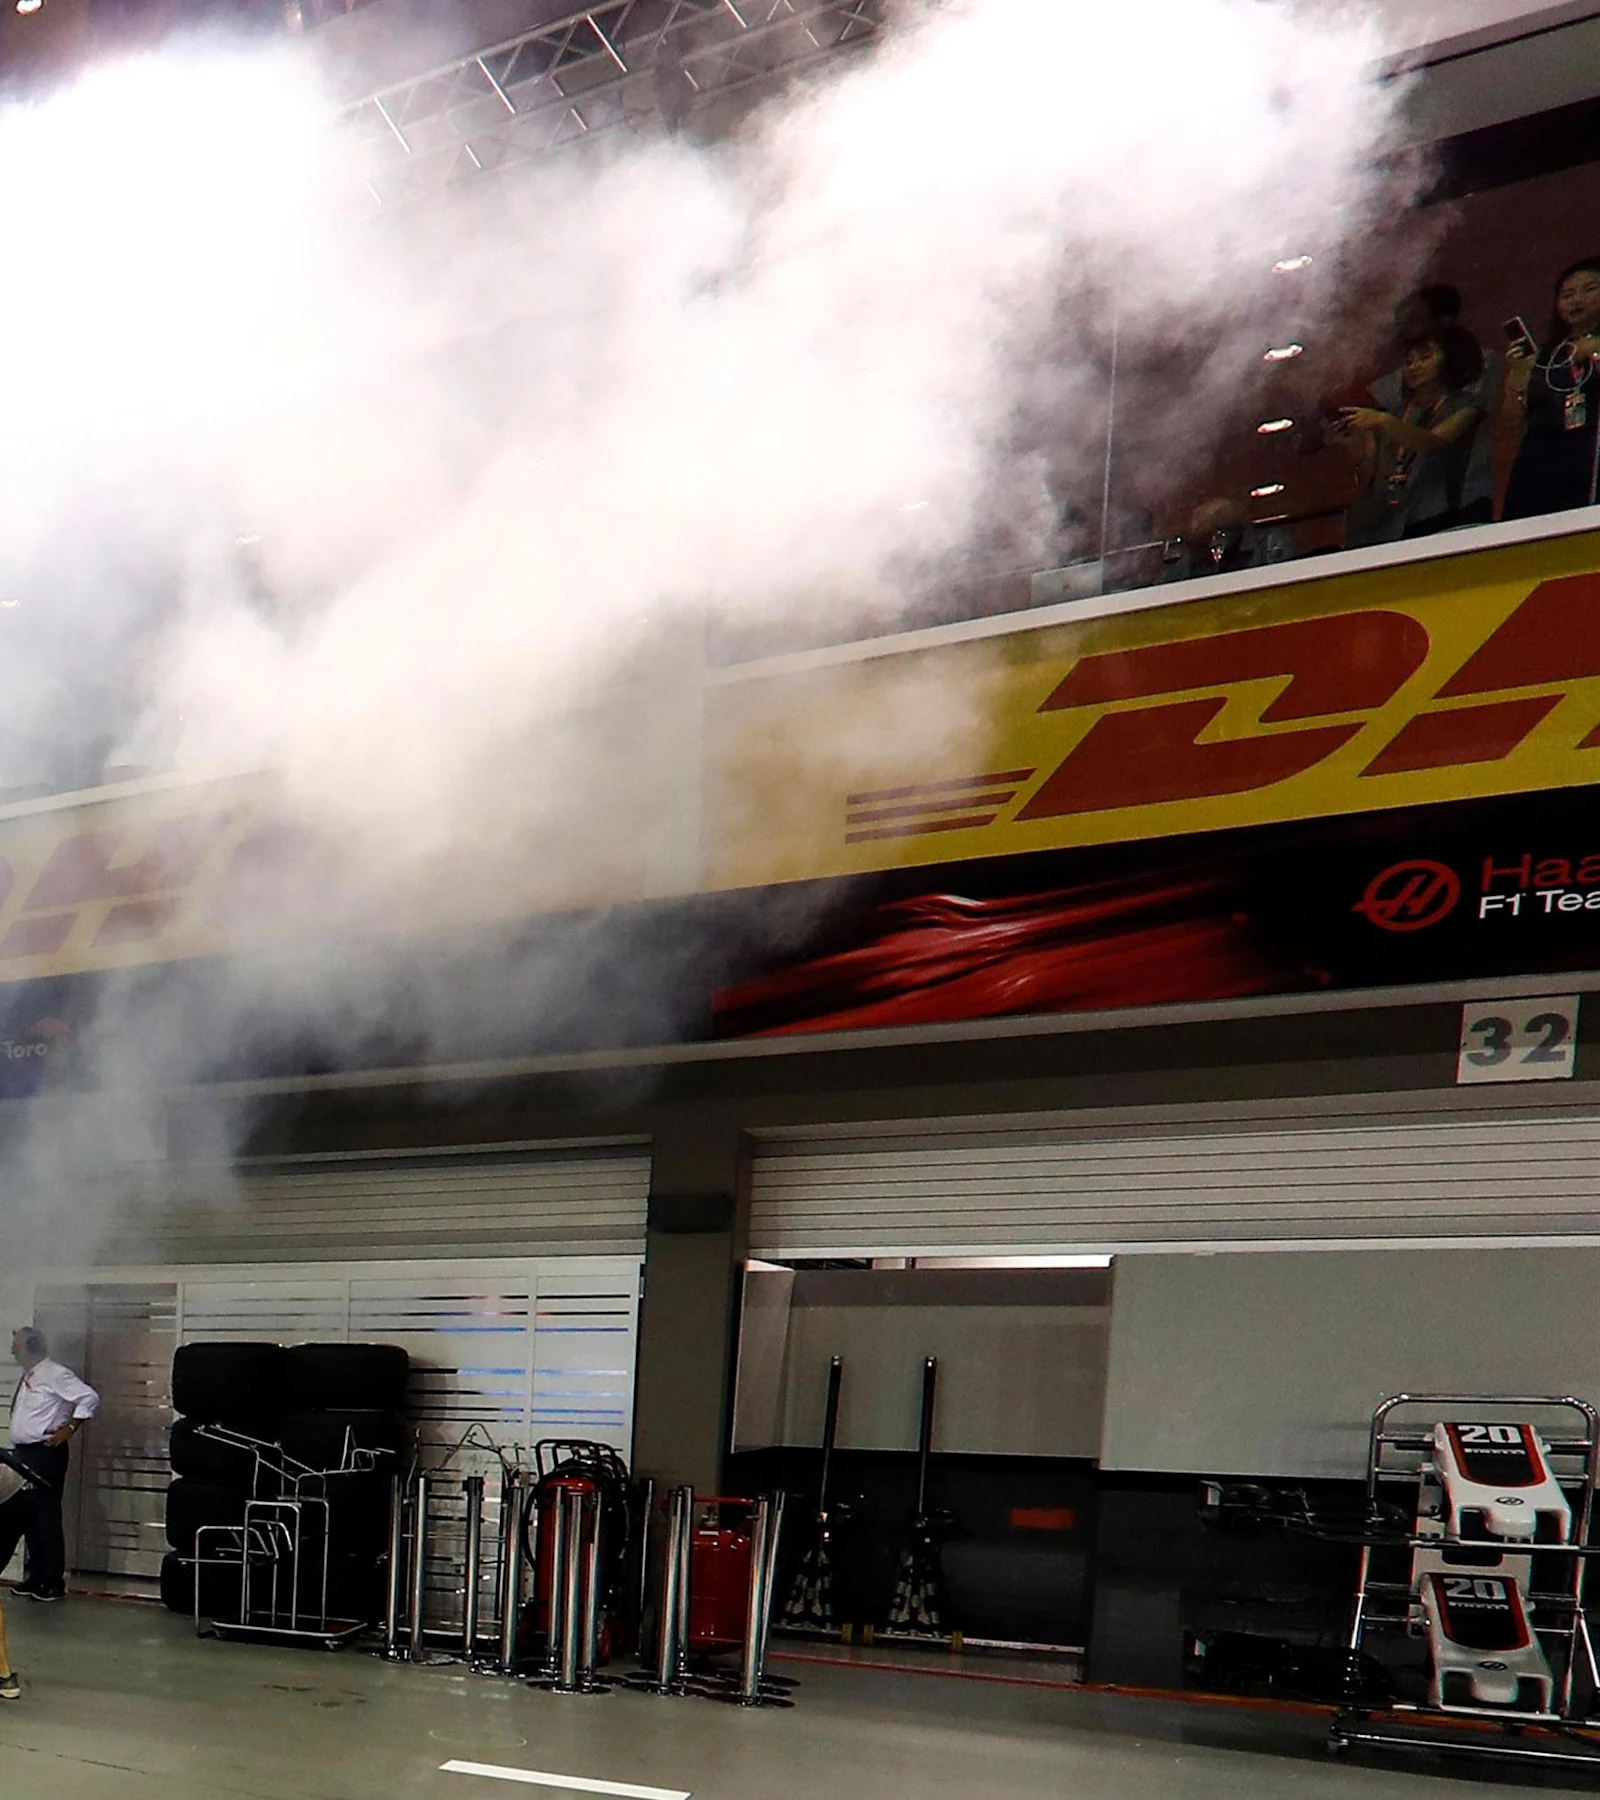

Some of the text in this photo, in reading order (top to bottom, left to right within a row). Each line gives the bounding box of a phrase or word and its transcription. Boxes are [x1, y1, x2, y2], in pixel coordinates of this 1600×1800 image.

[1482, 854, 1600, 892] Haa
[1479, 889, 1600, 919] F1 Tea
[3, 1040, 48, 1059] Toro
[1465, 1013, 1569, 1066] 32
[1458, 1425, 1523, 1443] 20
[1443, 1577, 1507, 1600] 20
